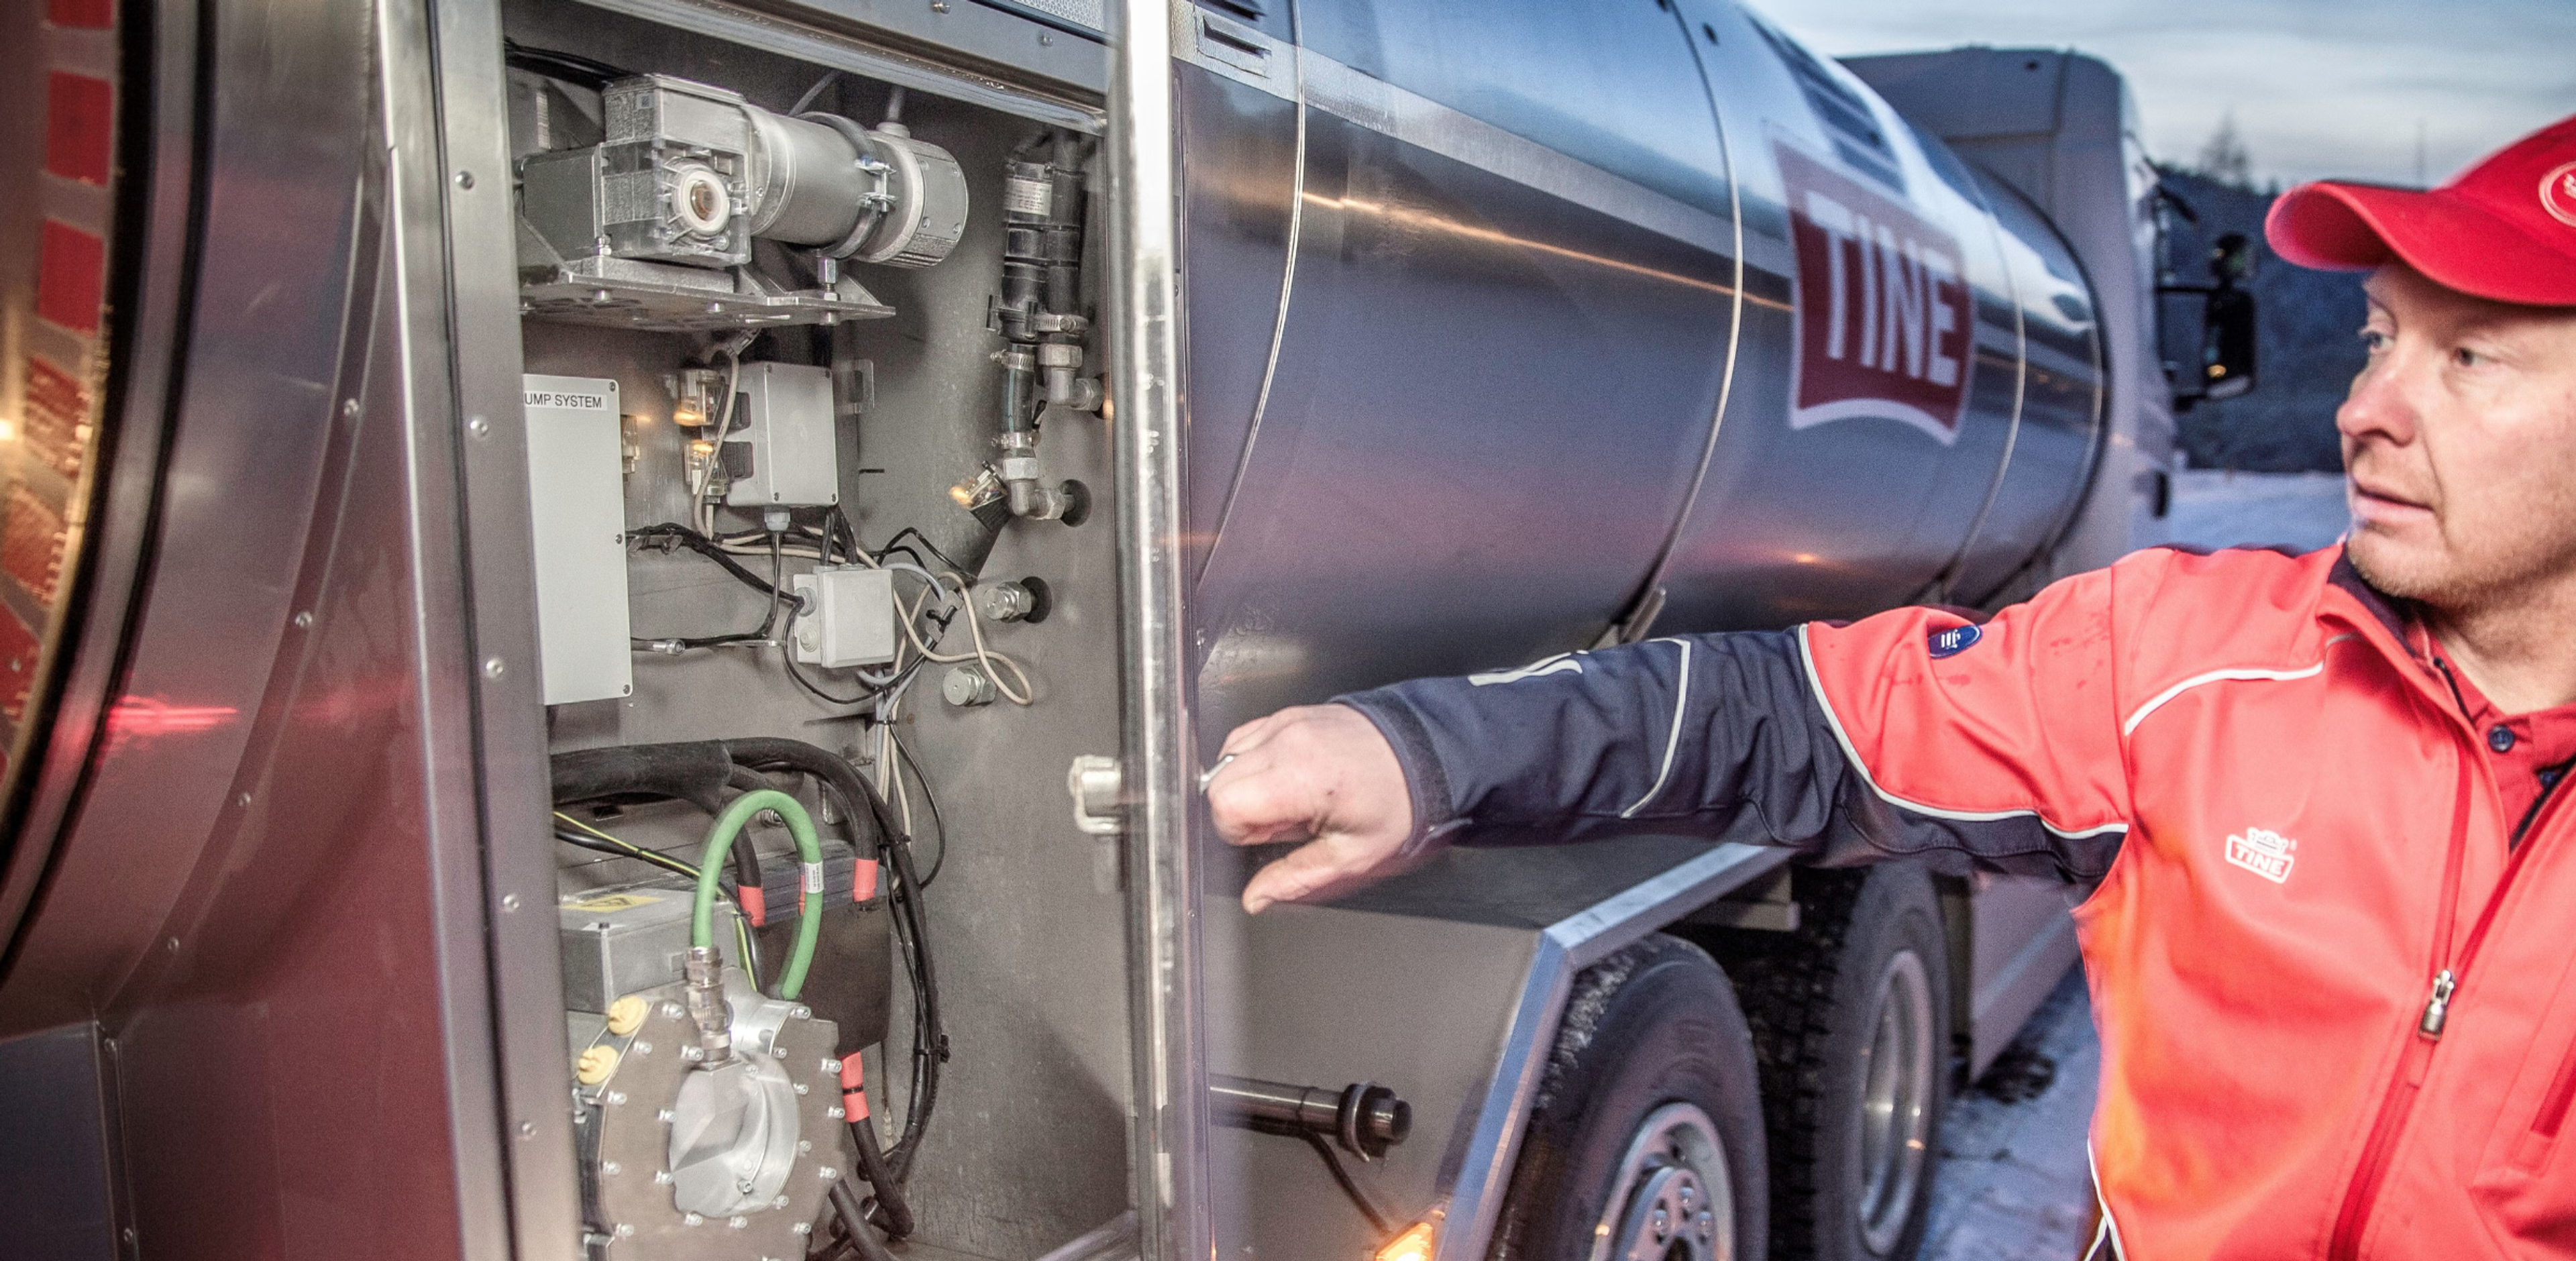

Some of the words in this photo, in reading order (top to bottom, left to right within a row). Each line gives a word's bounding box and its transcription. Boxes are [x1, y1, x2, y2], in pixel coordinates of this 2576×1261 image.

[1805, 190, 1958, 386] TINE
[555, 394, 602, 408] SYSTEM
[2236, 844, 2285, 875] TINE
